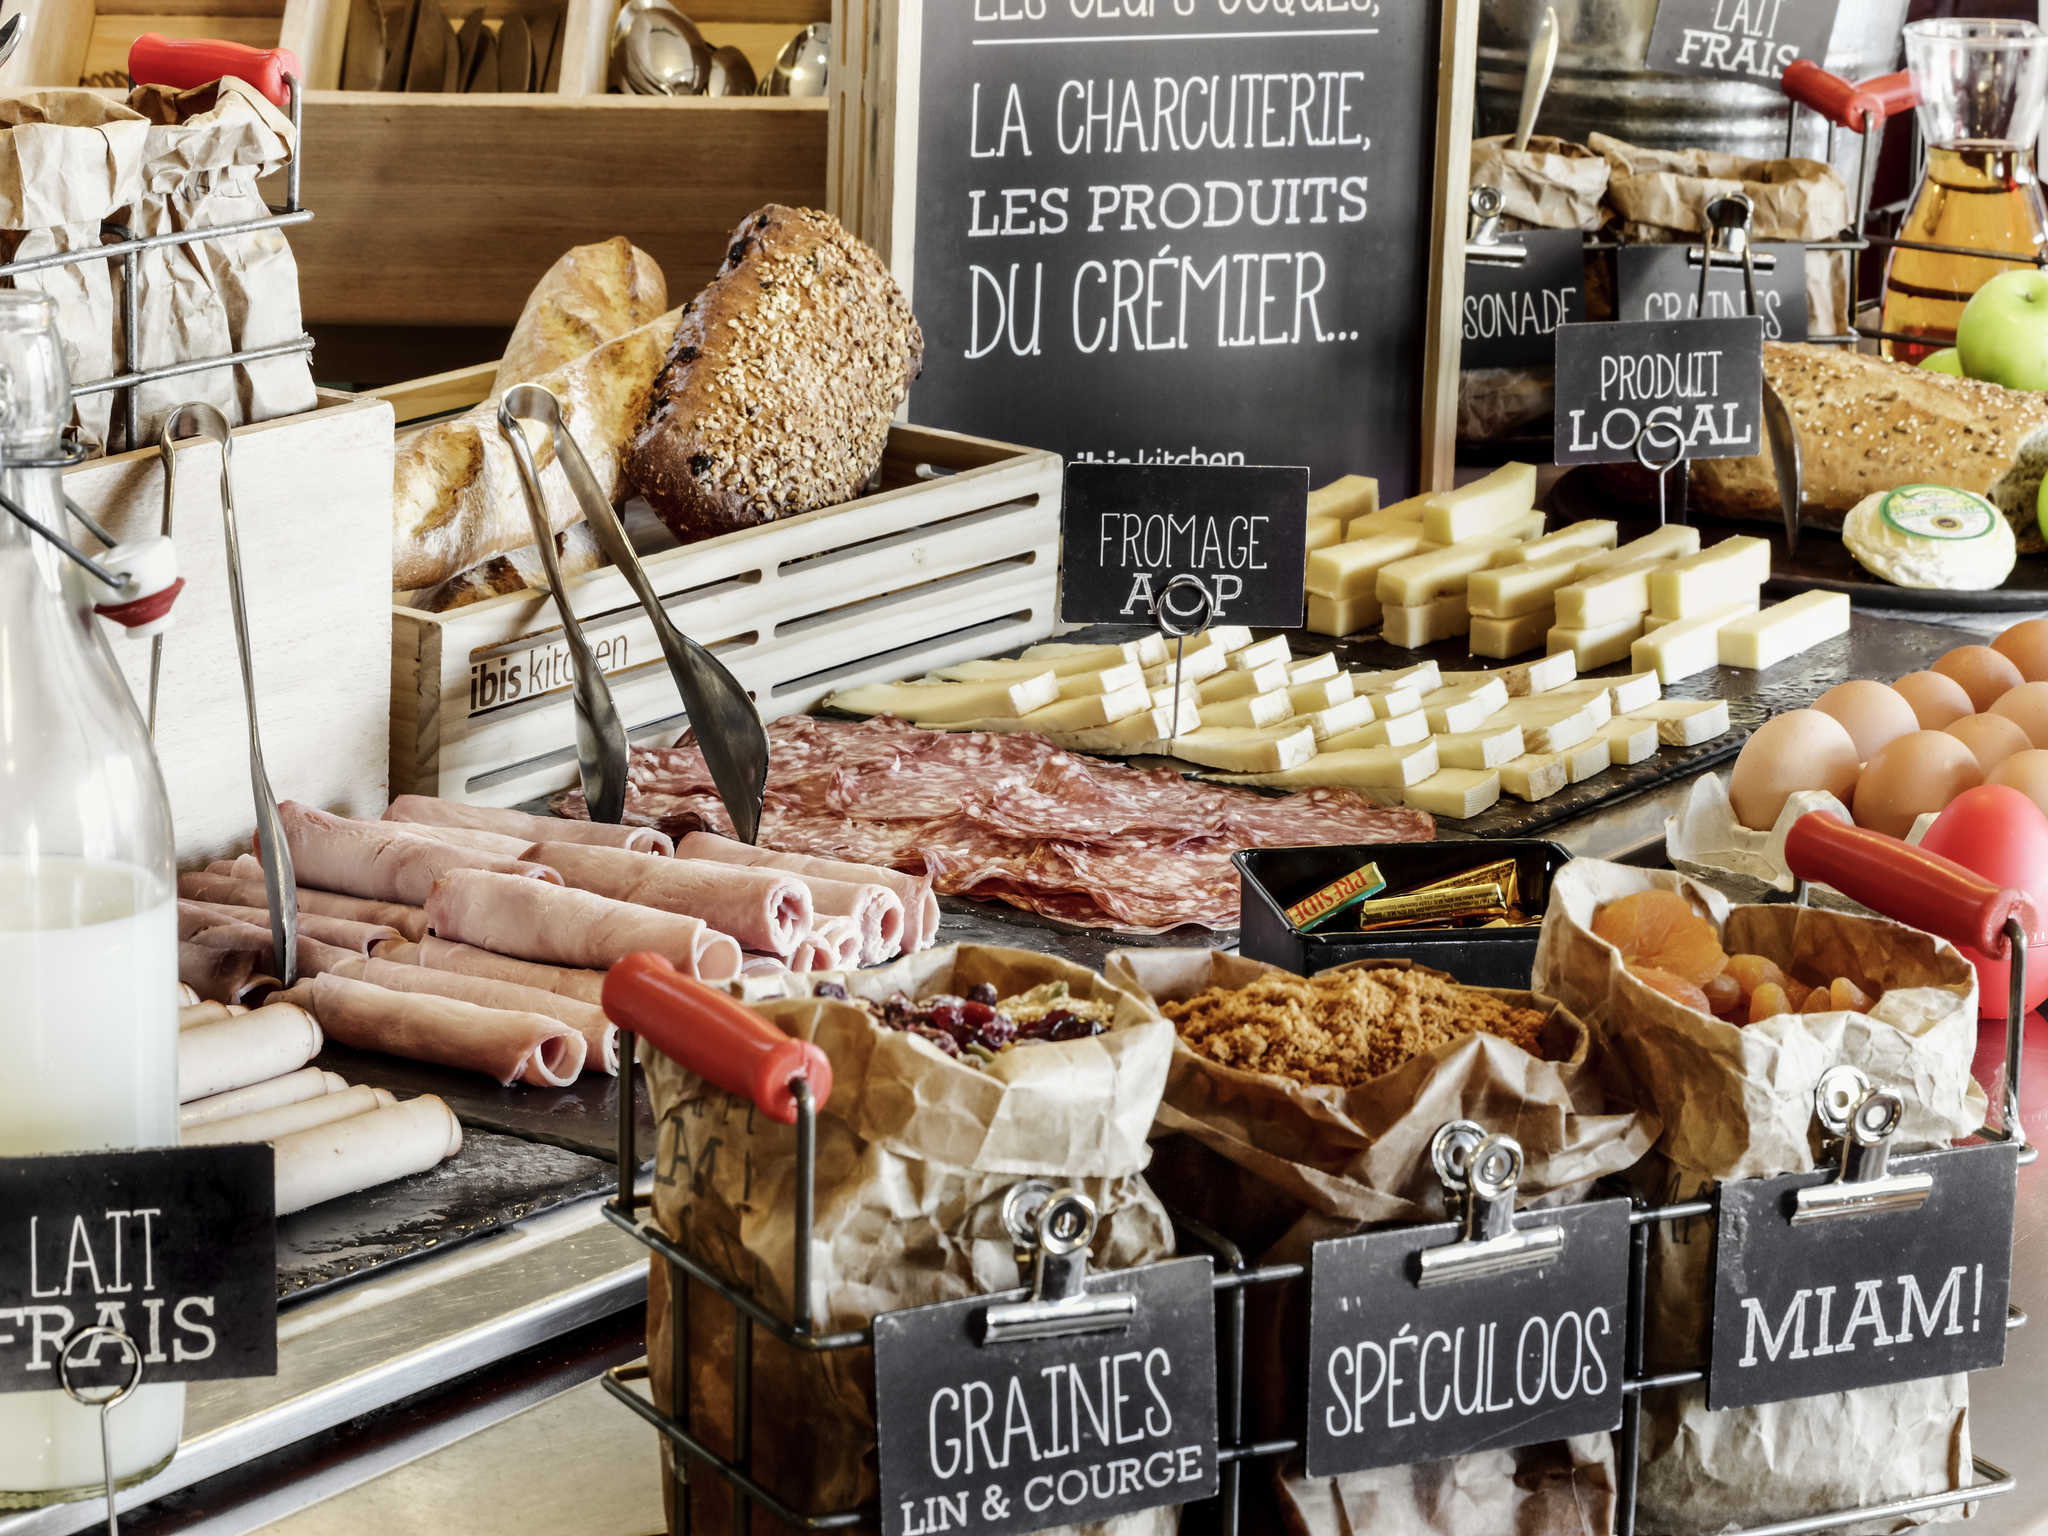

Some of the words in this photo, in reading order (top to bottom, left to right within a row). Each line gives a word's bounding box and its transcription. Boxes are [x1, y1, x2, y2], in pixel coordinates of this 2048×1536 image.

[1675, 29, 1800, 80] FRAIS
[970, 82, 1032, 158] LA
[1056, 71, 1371, 154] CHARCUTERIE,
[967, 187, 1070, 237] LES
[1087, 176, 1369, 233] PRODUITS
[964, 261, 1043, 360] DU
[1072, 243, 1360, 354] CRÉMIER...
[1462, 286, 1577, 340] SONADE
[1601, 350, 1723, 401] PRODUIT
[1568, 402, 1752, 452] LOCAL
[1099, 513, 1270, 570] FROMAGE
[1119, 572, 1244, 618] AOP
[469, 657, 522, 710] ibis
[528, 634, 628, 693] kitcen
[1285, 869, 1369, 926] PRESIDE
[31, 1208, 161, 1298] LAIT
[1738, 1263, 1984, 1368] MIAM!
[1325, 1306, 1610, 1437] SPÉCULOOS
[928, 1347, 1173, 1480] GRAINES
[900, 1490, 970, 1536] LIN
[981, 1483, 1011, 1521] &
[1024, 1445, 1203, 1513] COURGE
